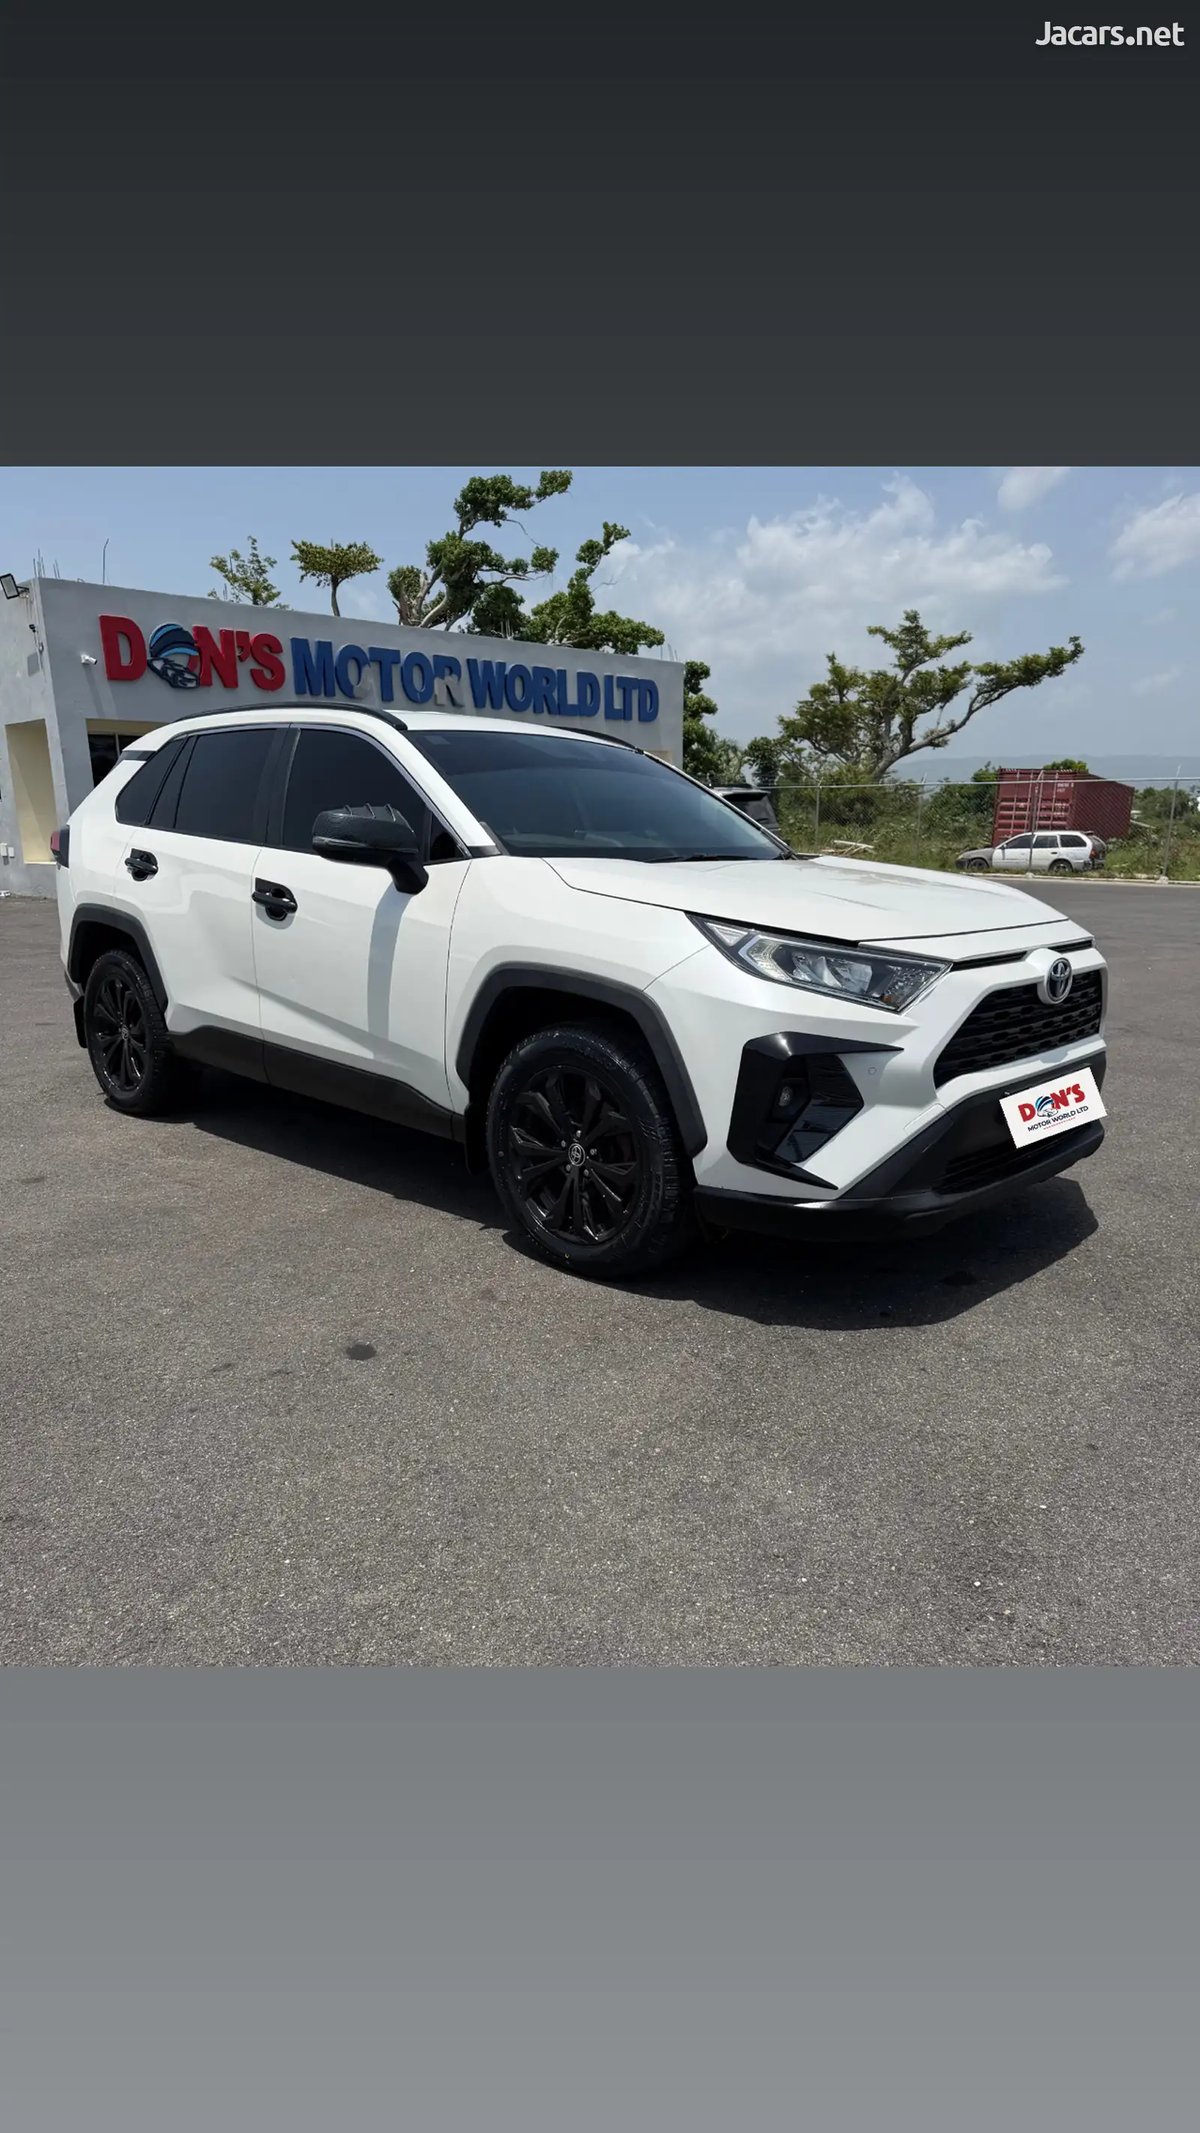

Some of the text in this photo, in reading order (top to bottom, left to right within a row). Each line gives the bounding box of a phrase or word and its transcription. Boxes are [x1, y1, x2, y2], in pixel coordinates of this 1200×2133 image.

[290, 637, 466, 708] MOTOR
[466, 657, 600, 718] WORLD
[604, 674, 660, 722] LTD
